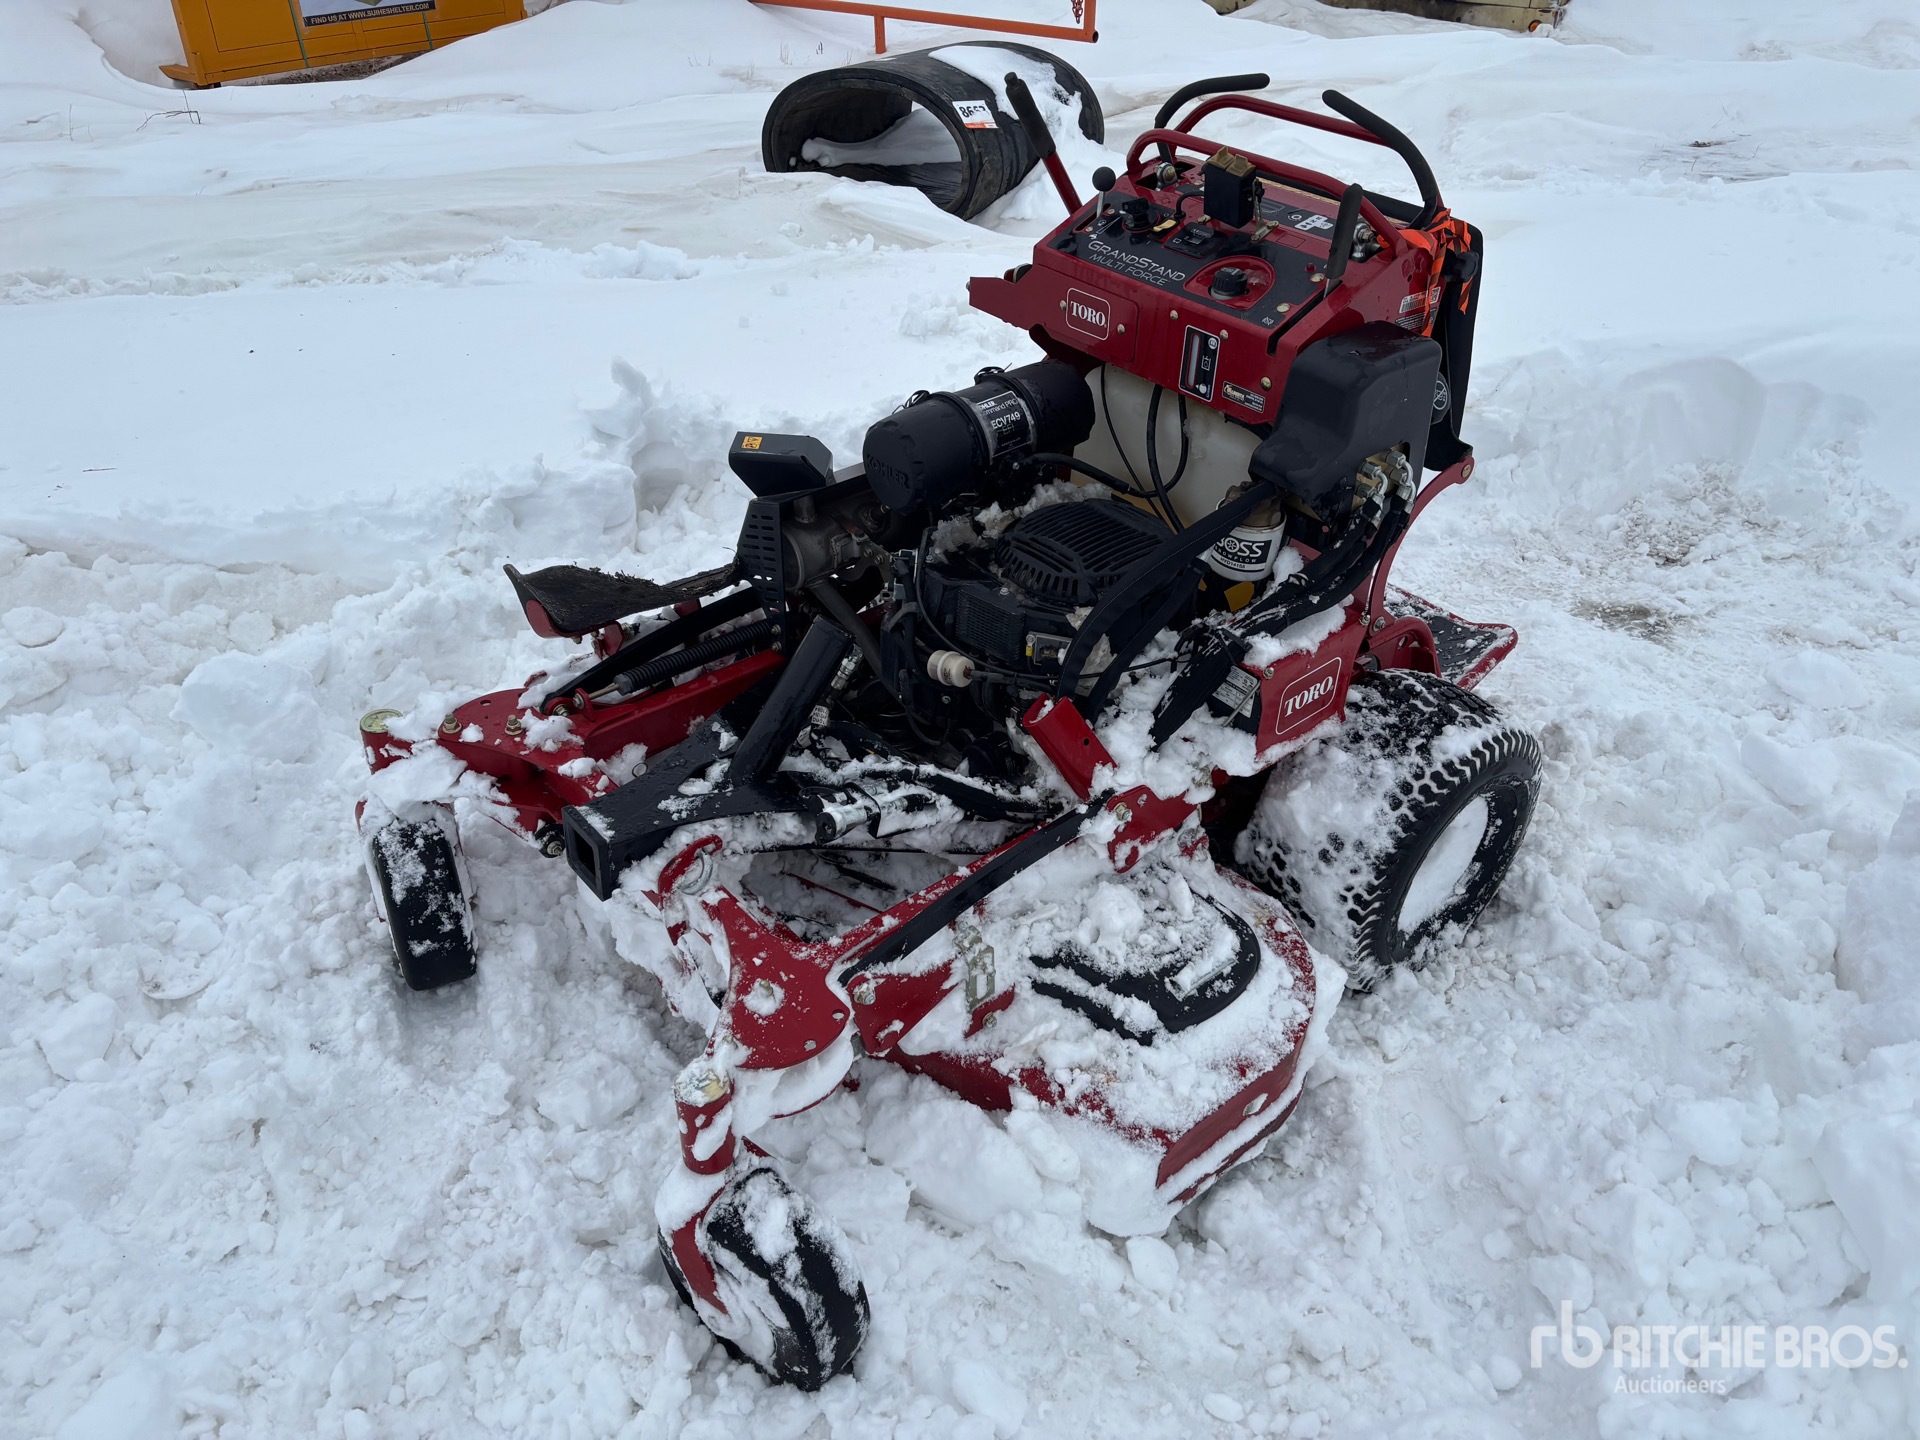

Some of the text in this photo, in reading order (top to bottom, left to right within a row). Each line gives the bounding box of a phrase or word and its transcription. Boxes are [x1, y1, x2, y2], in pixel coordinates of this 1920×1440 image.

[311, 15, 328, 24] FIND
[328, 14, 338, 22] US
[338, 13, 347, 21] AT
[1089, 254, 1167, 286] MULTI FORCE
[1070, 301, 1106, 327] TORO
[1005, 398, 1019, 408] PRO
[990, 411, 1021, 430] ECV749
[1283, 676, 1333, 718] TORO
